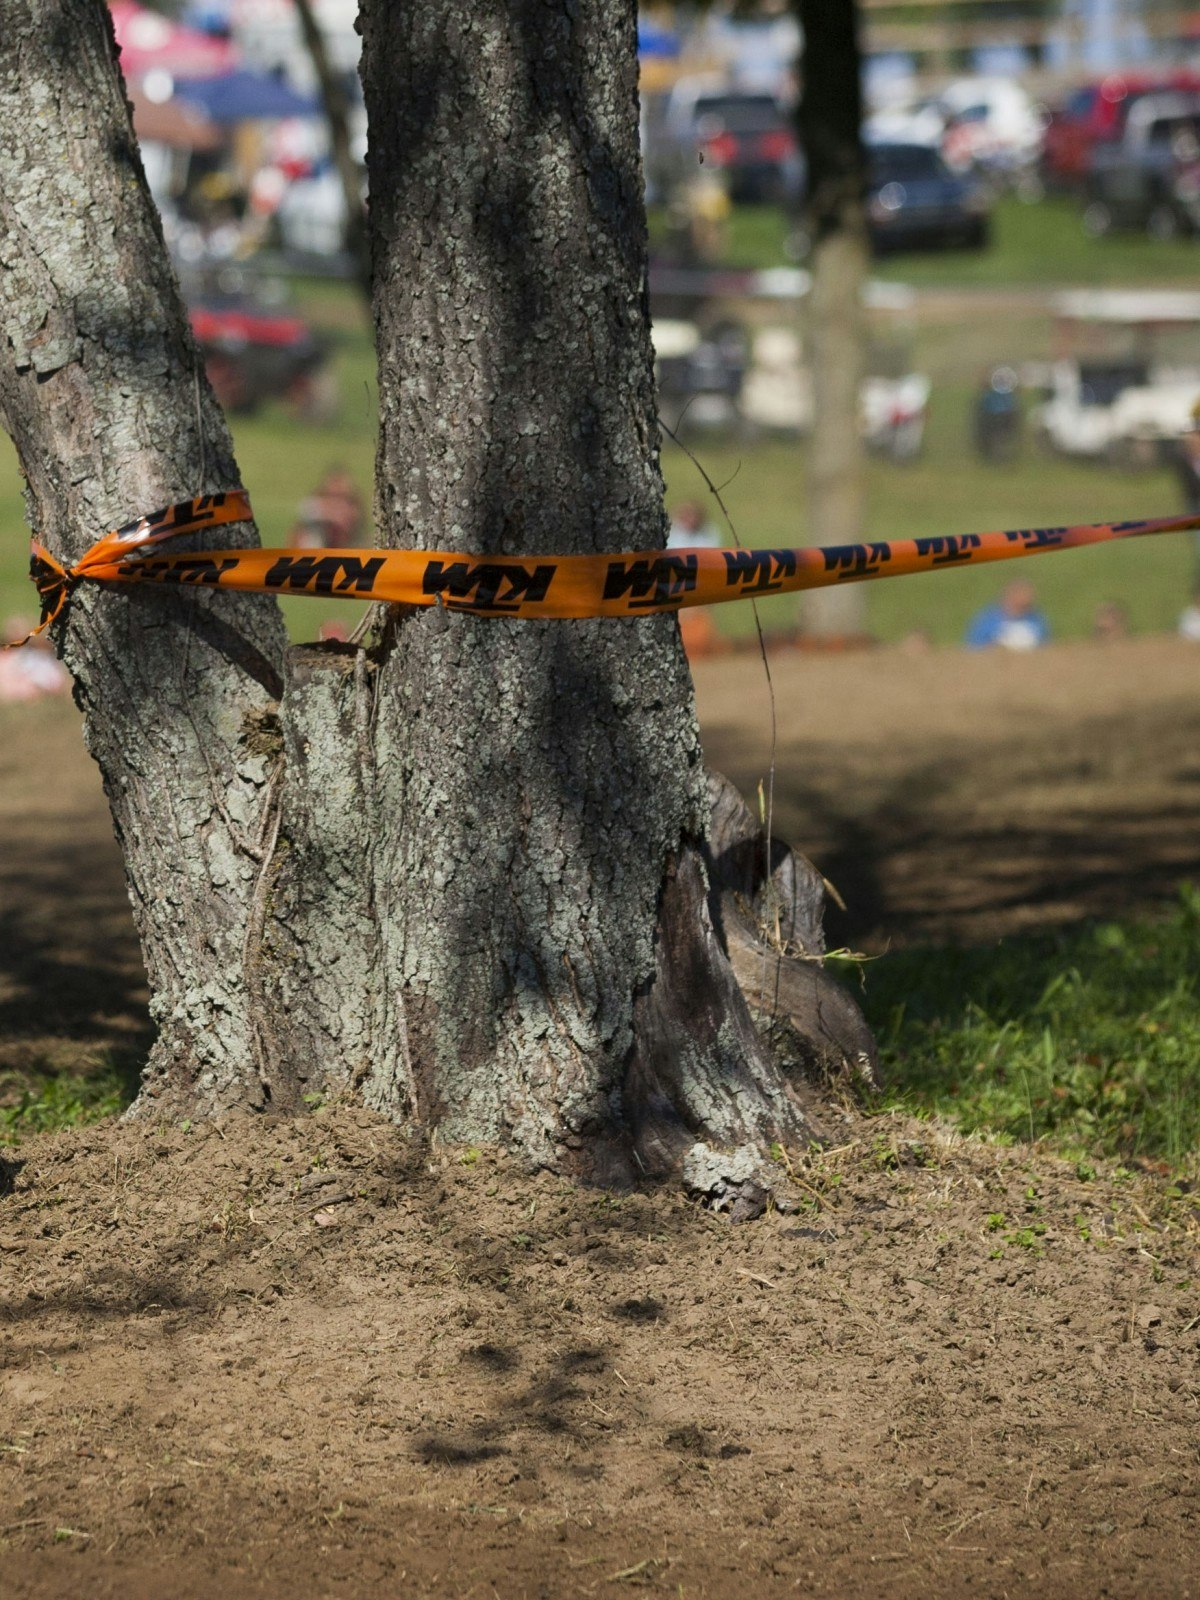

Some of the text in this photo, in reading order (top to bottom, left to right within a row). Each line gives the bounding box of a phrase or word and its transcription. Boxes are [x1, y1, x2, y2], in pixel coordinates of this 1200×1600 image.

[265, 556, 387, 599] KTM
[422, 560, 558, 612] KTM
[602, 554, 698, 609] KTM
[722, 549, 797, 594] KTM
